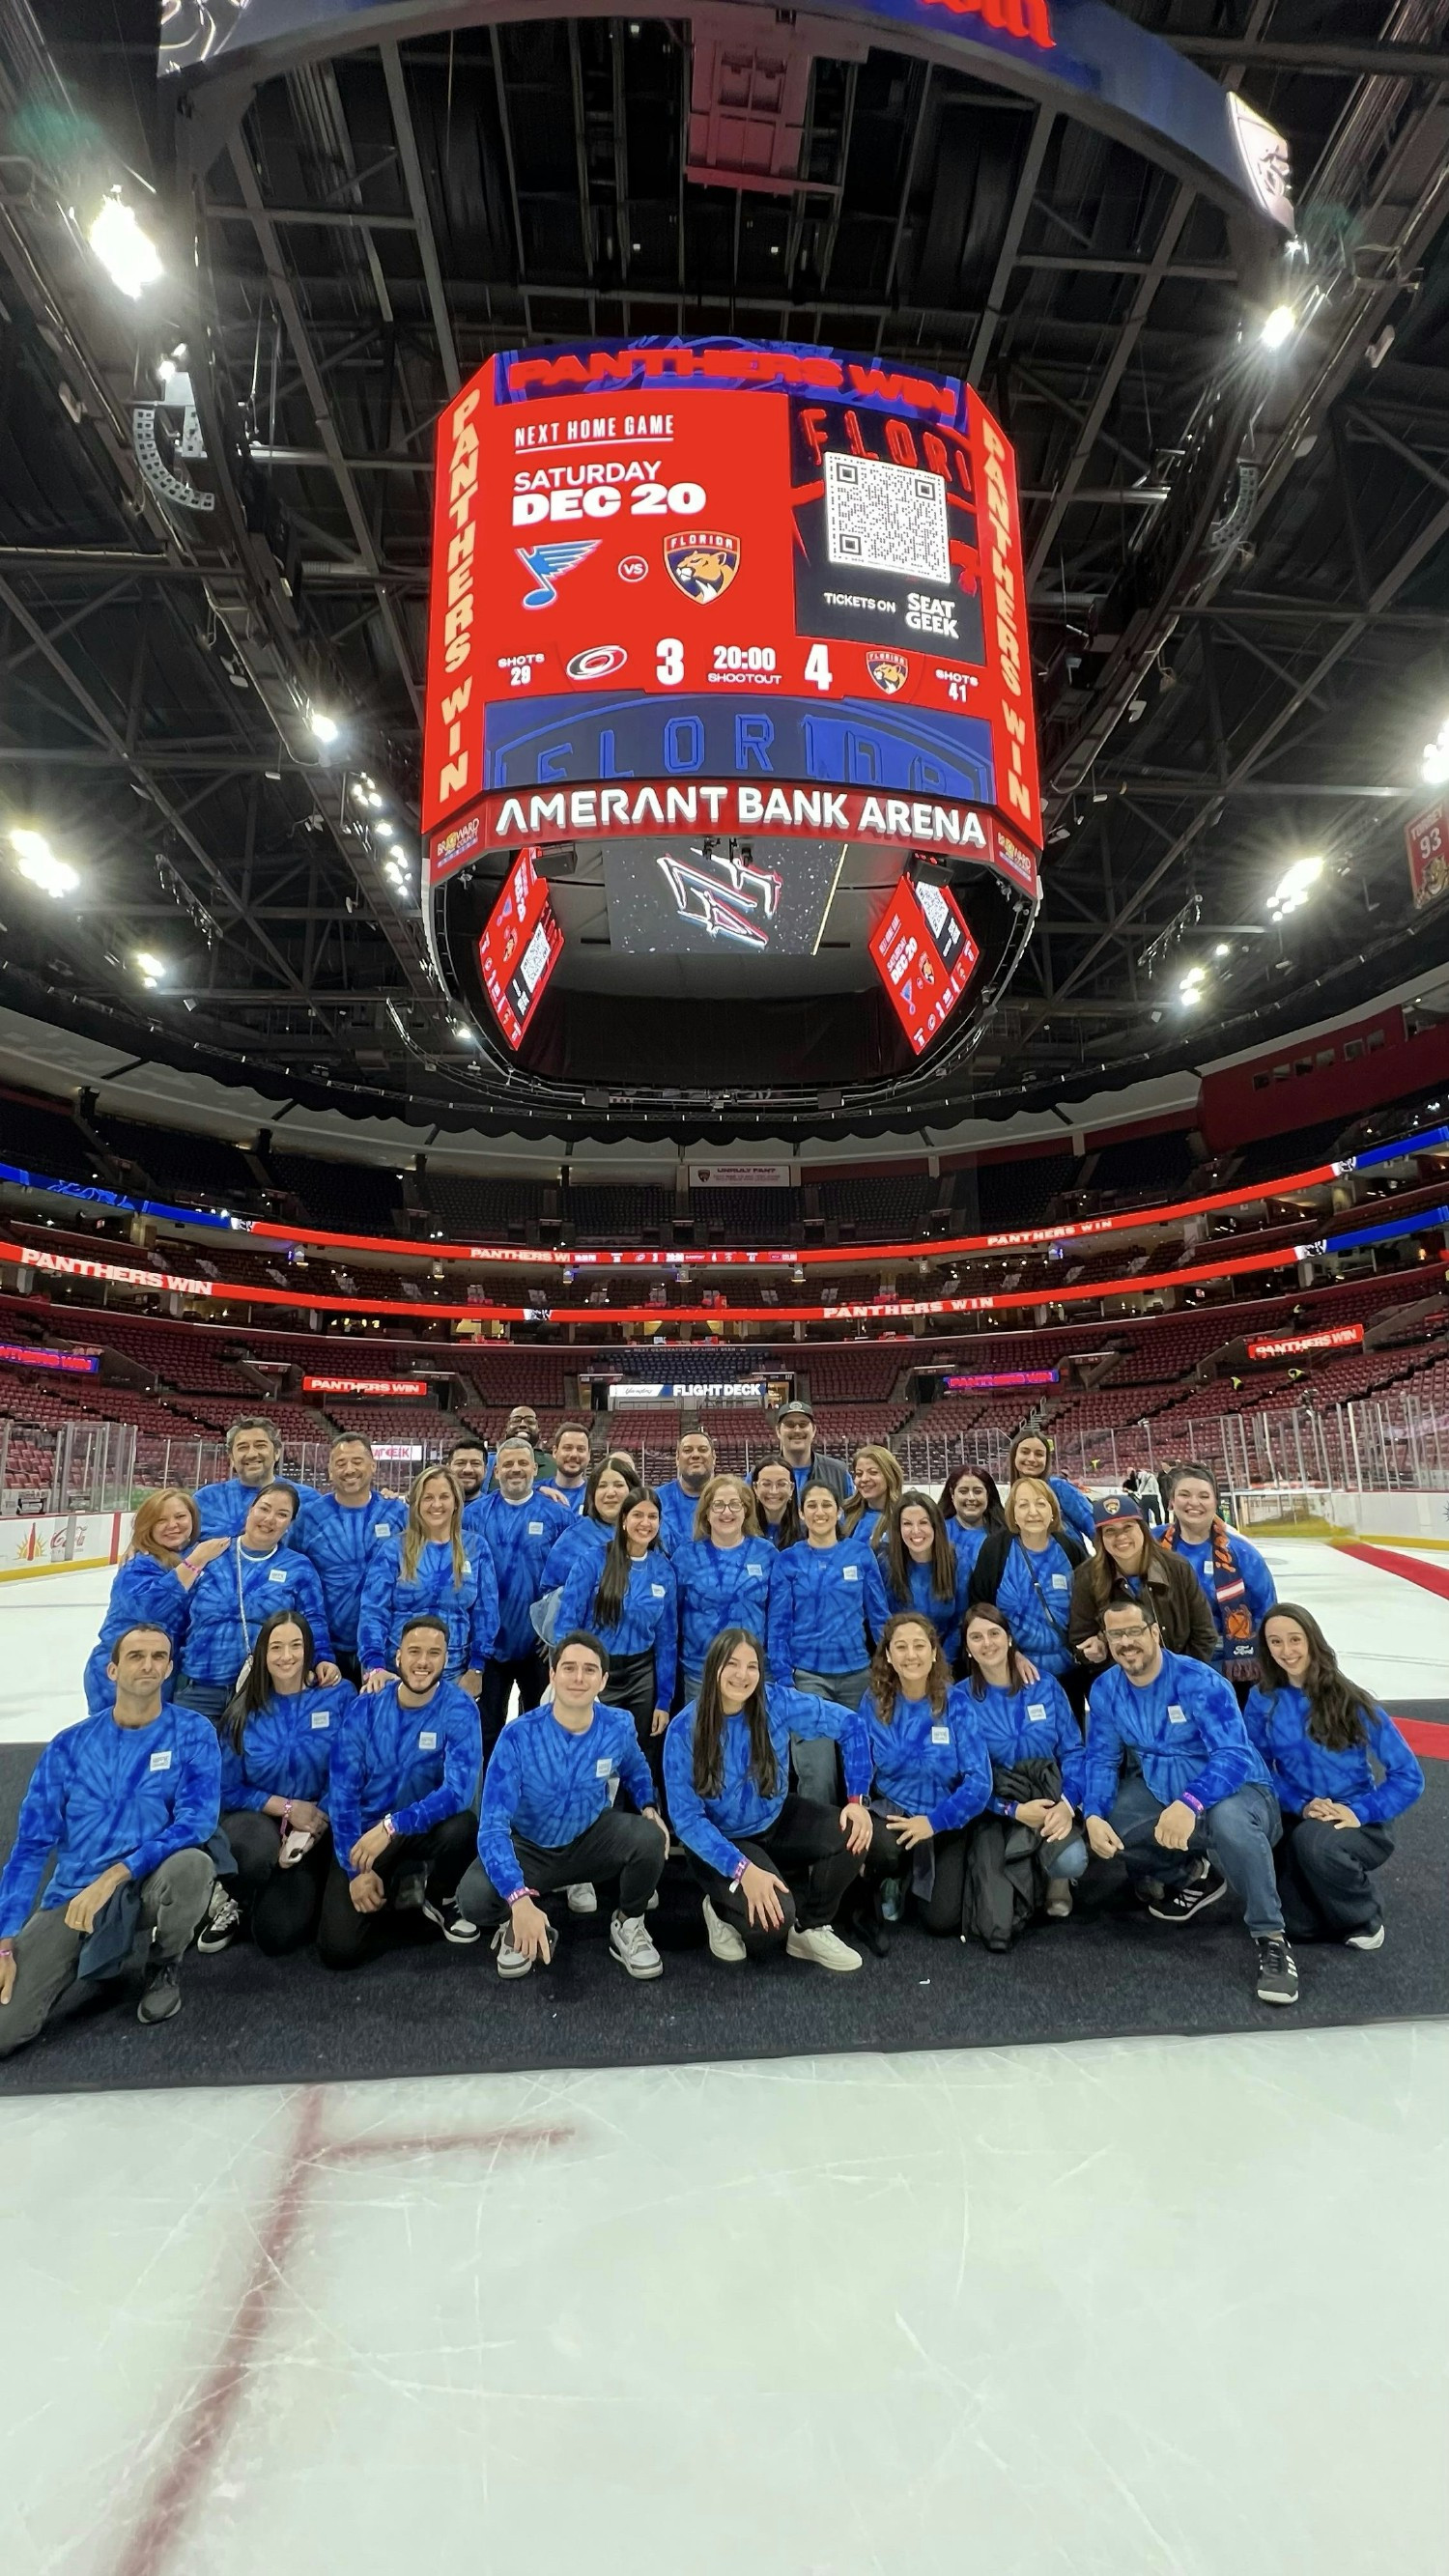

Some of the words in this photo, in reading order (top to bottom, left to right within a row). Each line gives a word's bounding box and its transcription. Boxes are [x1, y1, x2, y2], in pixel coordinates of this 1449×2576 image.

[509, 349, 843, 390] PANTHERS
[848, 364, 956, 416] WIN
[515, 422, 559, 447] NEXT
[567, 417, 616, 440] HOME
[624, 414, 674, 436] GAME
[514, 460, 662, 493] SATURDAY
[512, 486, 621, 526] DEC
[631, 482, 707, 515] 20
[444, 388, 480, 673] PANTHERS
[670, 533, 734, 549] FLORIDA
[622, 563, 643, 575] VS
[982, 417, 1022, 697] PANTHERS
[823, 592, 875, 610] TICKETS
[877, 600, 896, 613] ON
[907, 592, 955, 618] SEAT
[905, 611, 959, 639] GEEK
[497, 654, 545, 667] SHOTS
[656, 637, 685, 686] 3
[713, 645, 776, 671] 20:00
[804, 643, 833, 691] 4
[707, 672, 782, 685] SHOOTOUT
[935, 668, 979, 687] SHOTS
[948, 683, 967, 702] 41
[440, 675, 472, 804] WIN
[1001, 698, 1031, 822] WIN
[495, 786, 728, 835] AMERANT
[738, 786, 850, 830] BANK
[858, 796, 987, 849] ARENA
[1420, 828, 1441, 859] 93
[890, 953, 908, 985] DEC
[905, 937, 918, 962] 20
[986, 1226, 1075, 1246] PANTHERS
[1081, 1220, 1112, 1232] WIN
[470, 1247, 553, 1261] PANTHERS
[22, 1248, 164, 1288] PANTHERS
[165, 1276, 213, 1295] WIN
[823, 1301, 943, 1318] PANTHERS
[952, 1297, 994, 1311] WIN
[1256, 1335, 1331, 1357] PANTHERS
[1332, 1329, 1356, 1345] WIN
[311, 1379, 390, 1392] PANTHERS
[392, 1384, 419, 1393] WIN
[673, 1384, 723, 1397] FLIGHT
[724, 1383, 761, 1396] DECK
[1233, 1645, 1254, 1656] Ford
